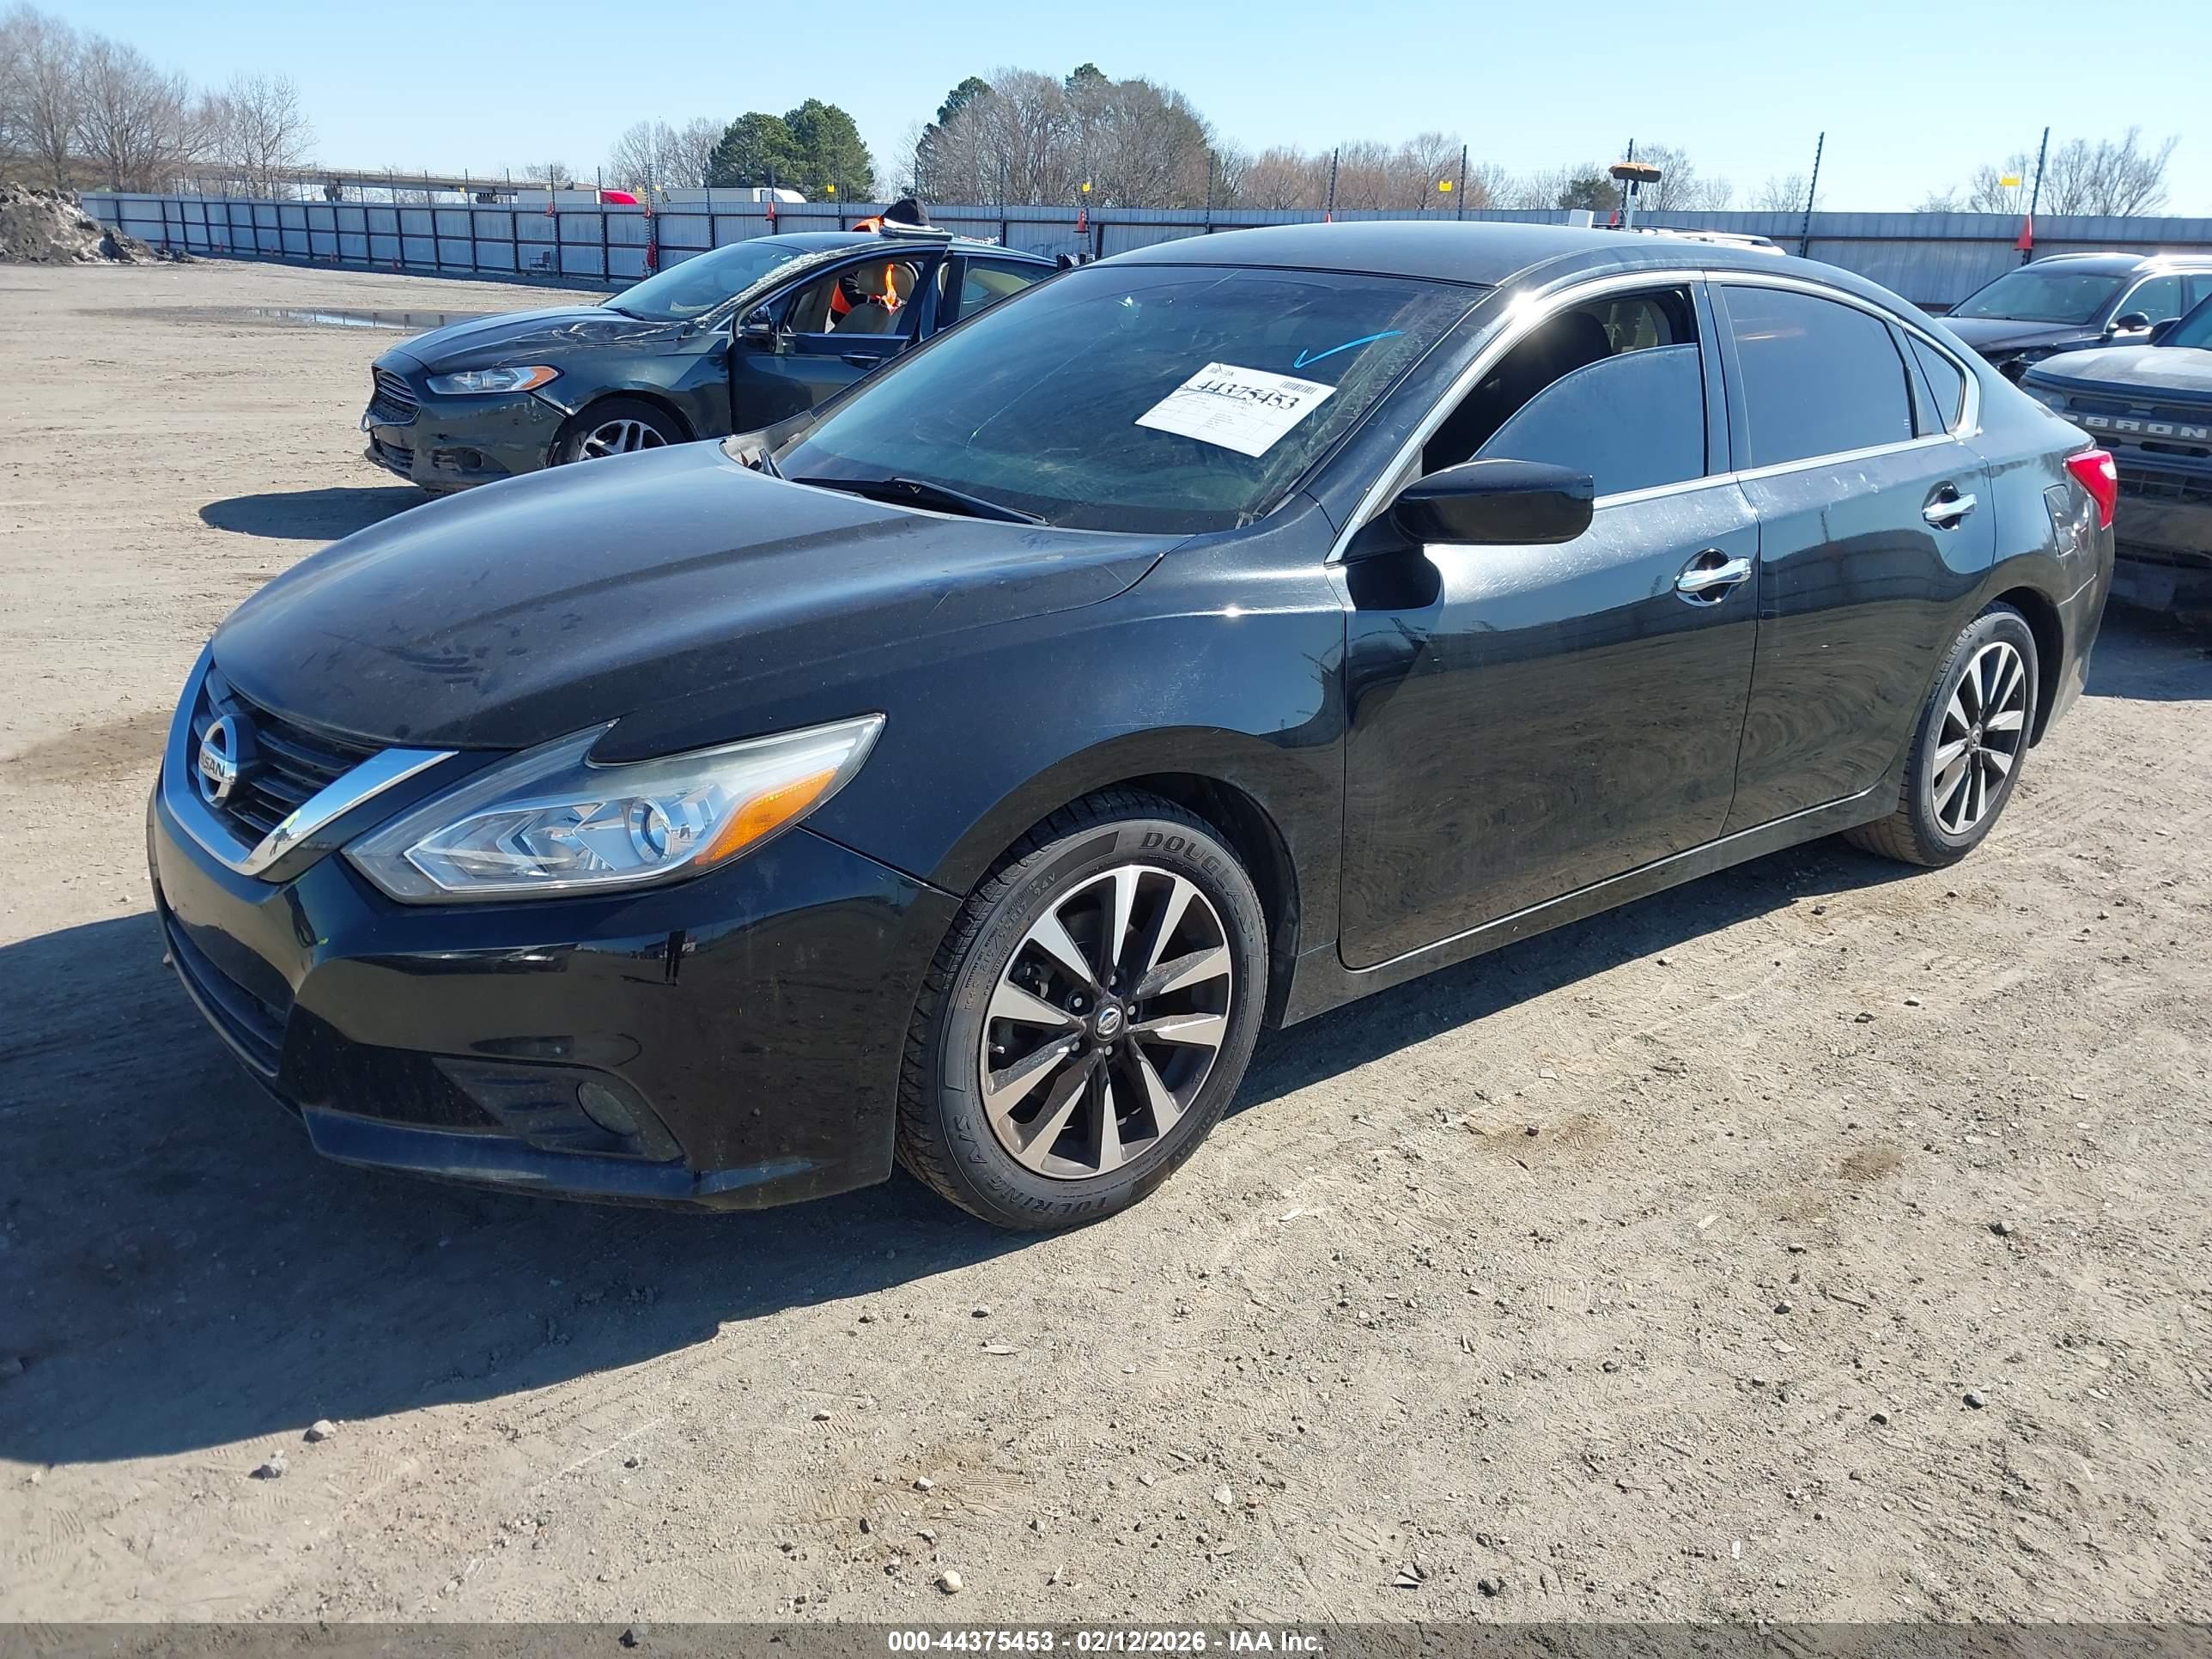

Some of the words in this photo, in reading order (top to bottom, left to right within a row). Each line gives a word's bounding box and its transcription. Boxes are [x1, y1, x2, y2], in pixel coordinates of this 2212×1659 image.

[1197, 380, 1300, 410] 44375453
[1139, 830, 1255, 934] DOUGLAS
[988, 1175, 1108, 1217] TOURING
